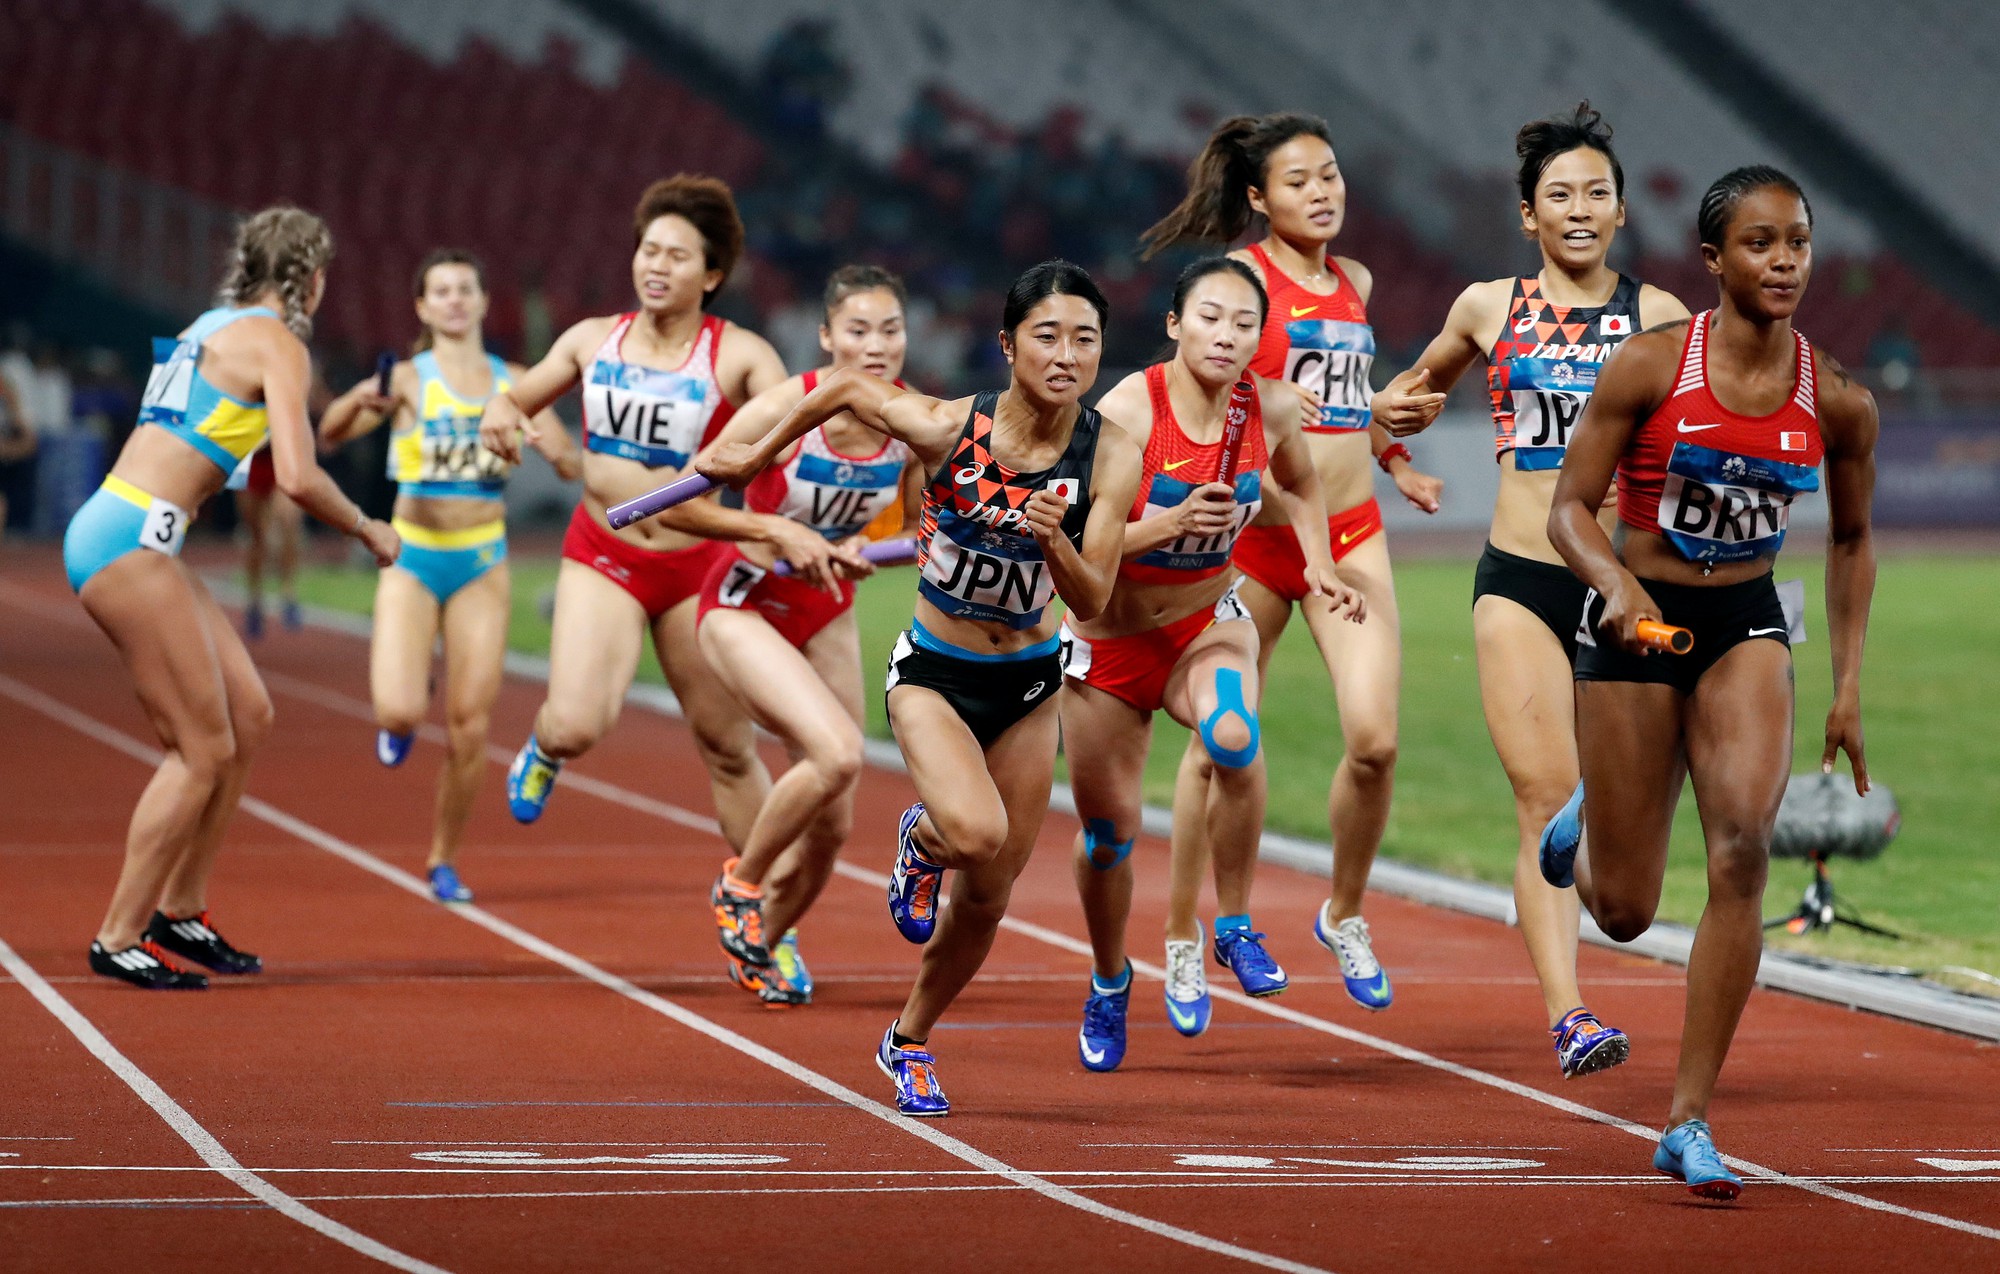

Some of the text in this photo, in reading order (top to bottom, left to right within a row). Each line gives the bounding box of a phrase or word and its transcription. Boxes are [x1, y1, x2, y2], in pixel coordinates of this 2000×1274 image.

[1292, 351, 1371, 407] CHN
[606, 390, 675, 445] VIE
[1532, 391, 1592, 446] JP
[1219, 449, 1231, 473] ASIAN
[811, 487, 878, 525] VIE
[957, 501, 1034, 533] JAPA
[1673, 479, 1794, 541] BRN
[156, 511, 175, 543] 3
[727, 566, 755, 597] 7
[937, 548, 1044, 613] JPN
[973, 610, 1009, 623] PERTAMINA
